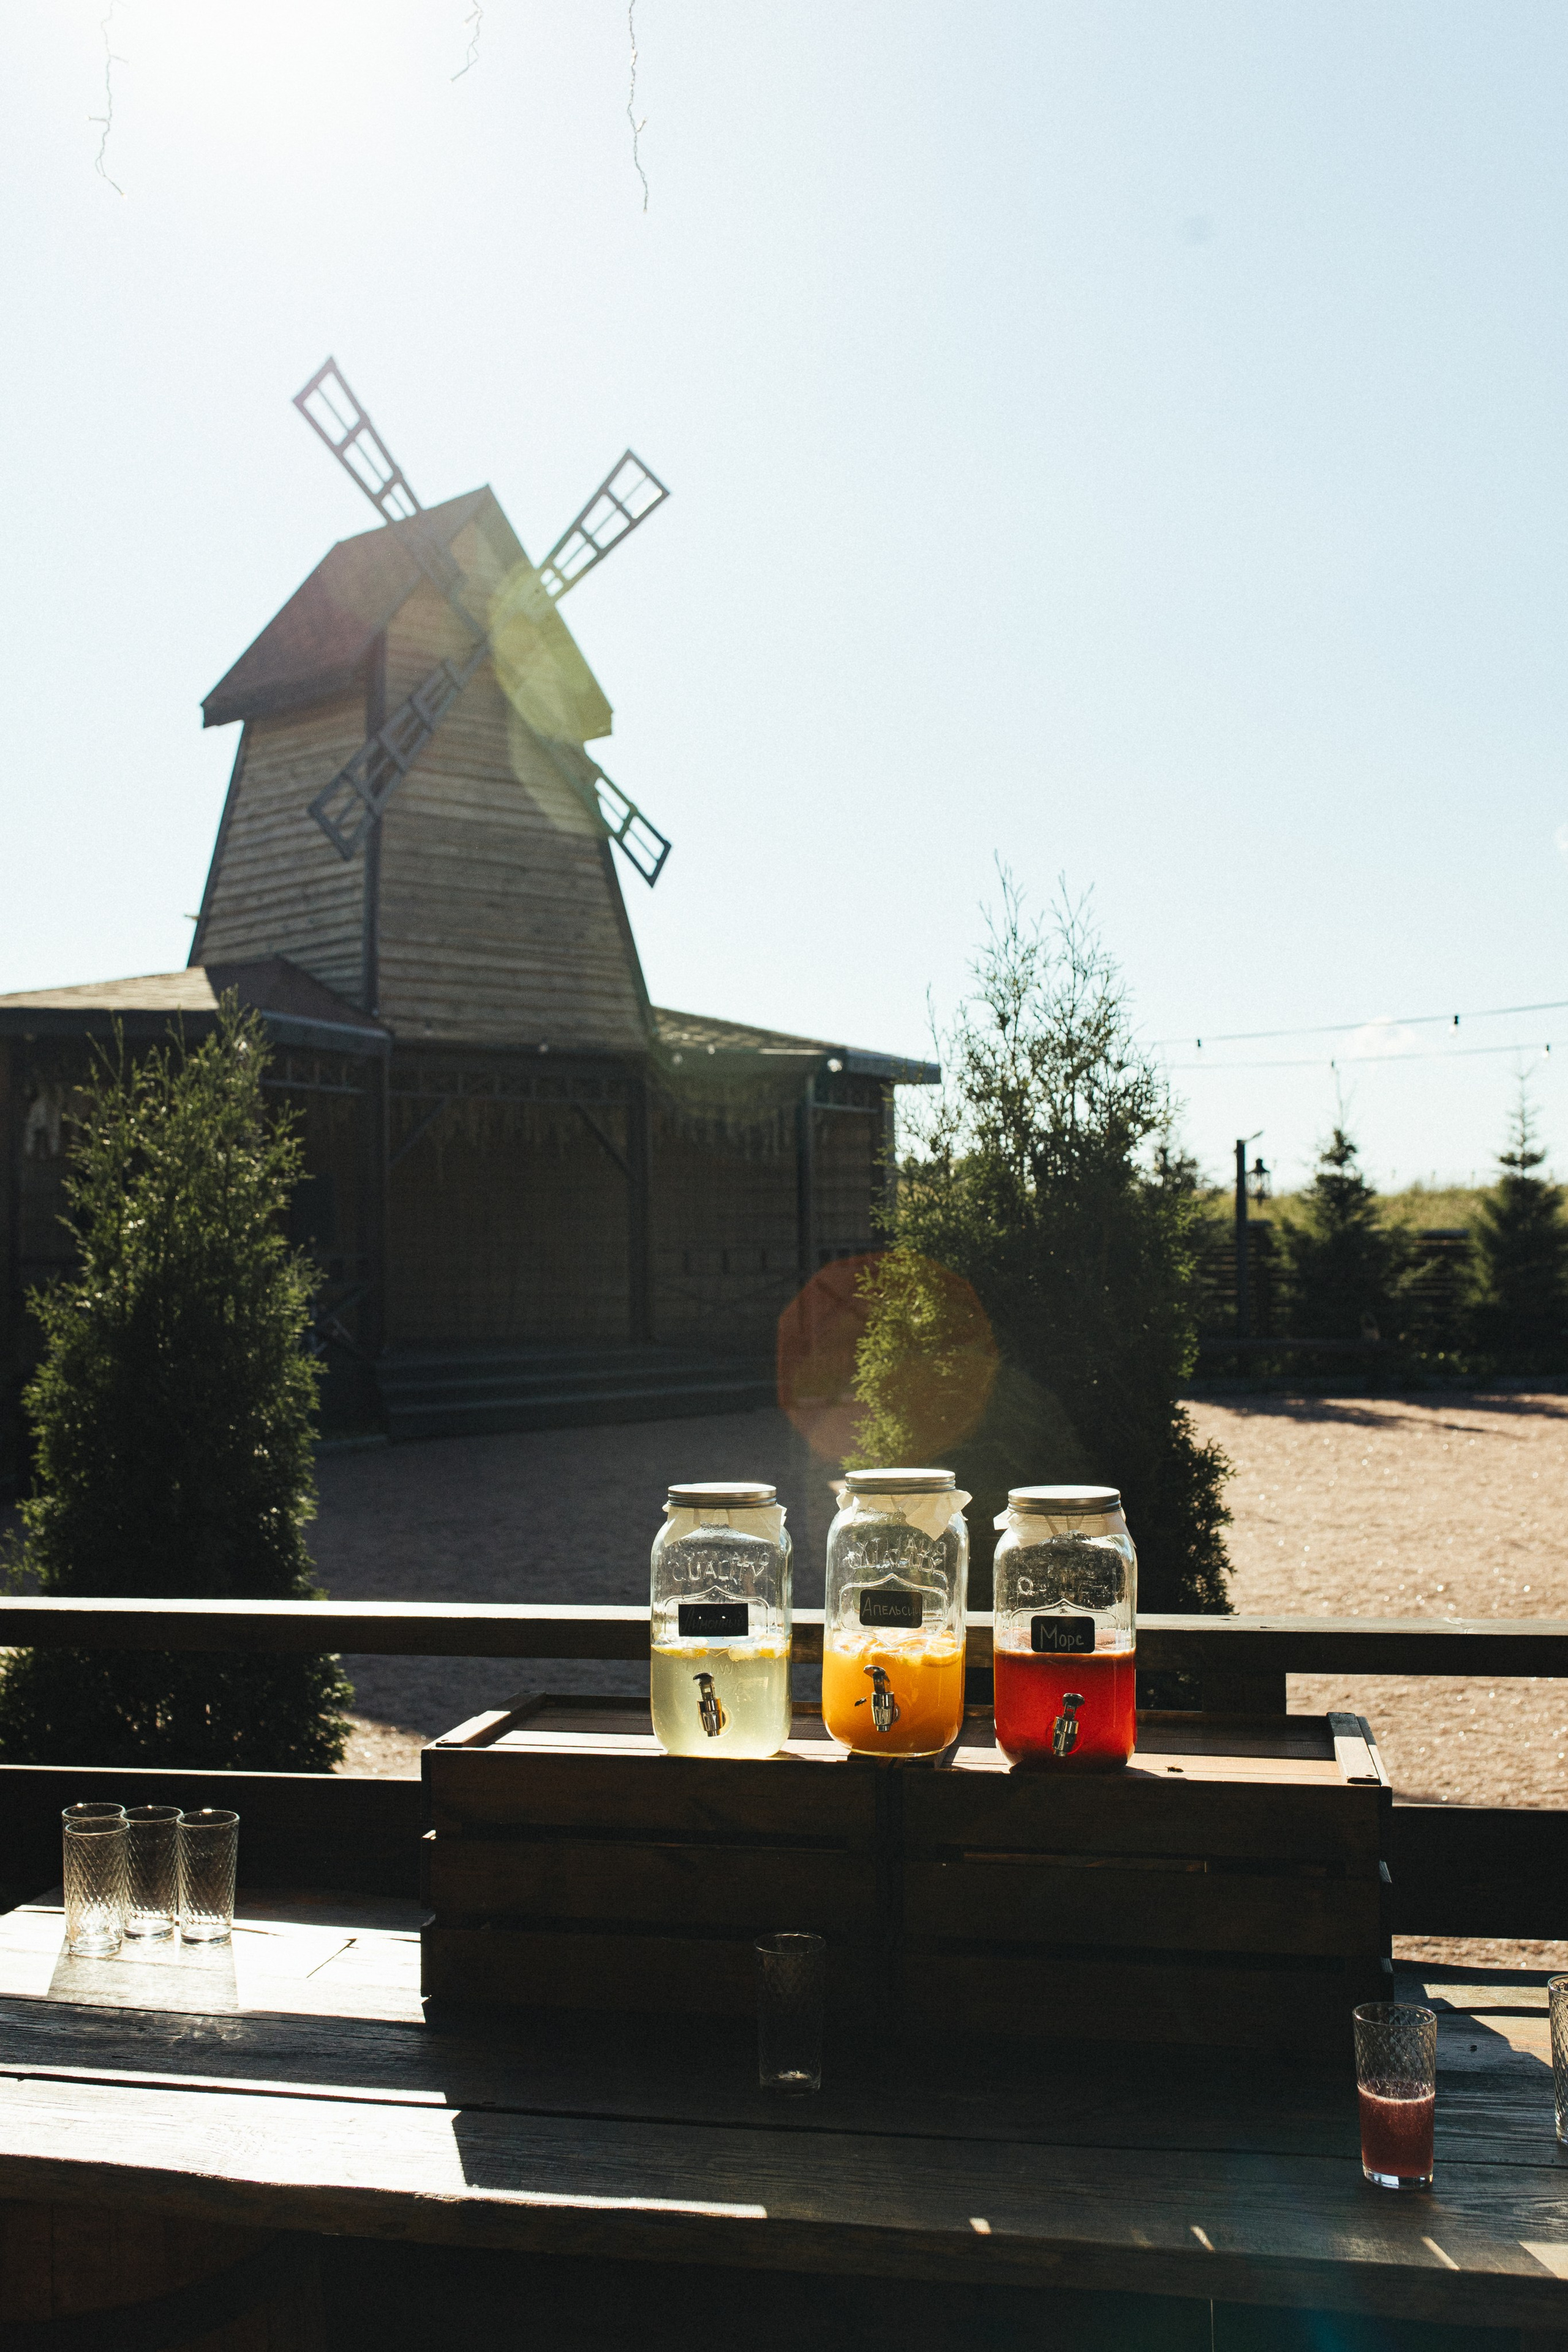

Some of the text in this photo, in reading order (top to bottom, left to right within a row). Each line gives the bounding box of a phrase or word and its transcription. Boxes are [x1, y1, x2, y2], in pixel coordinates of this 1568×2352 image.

[861, 1596, 921, 1616] Апельсин
[1040, 1623, 1084, 1651] Морс
[676, 1660, 760, 1676] GLASSWAR
